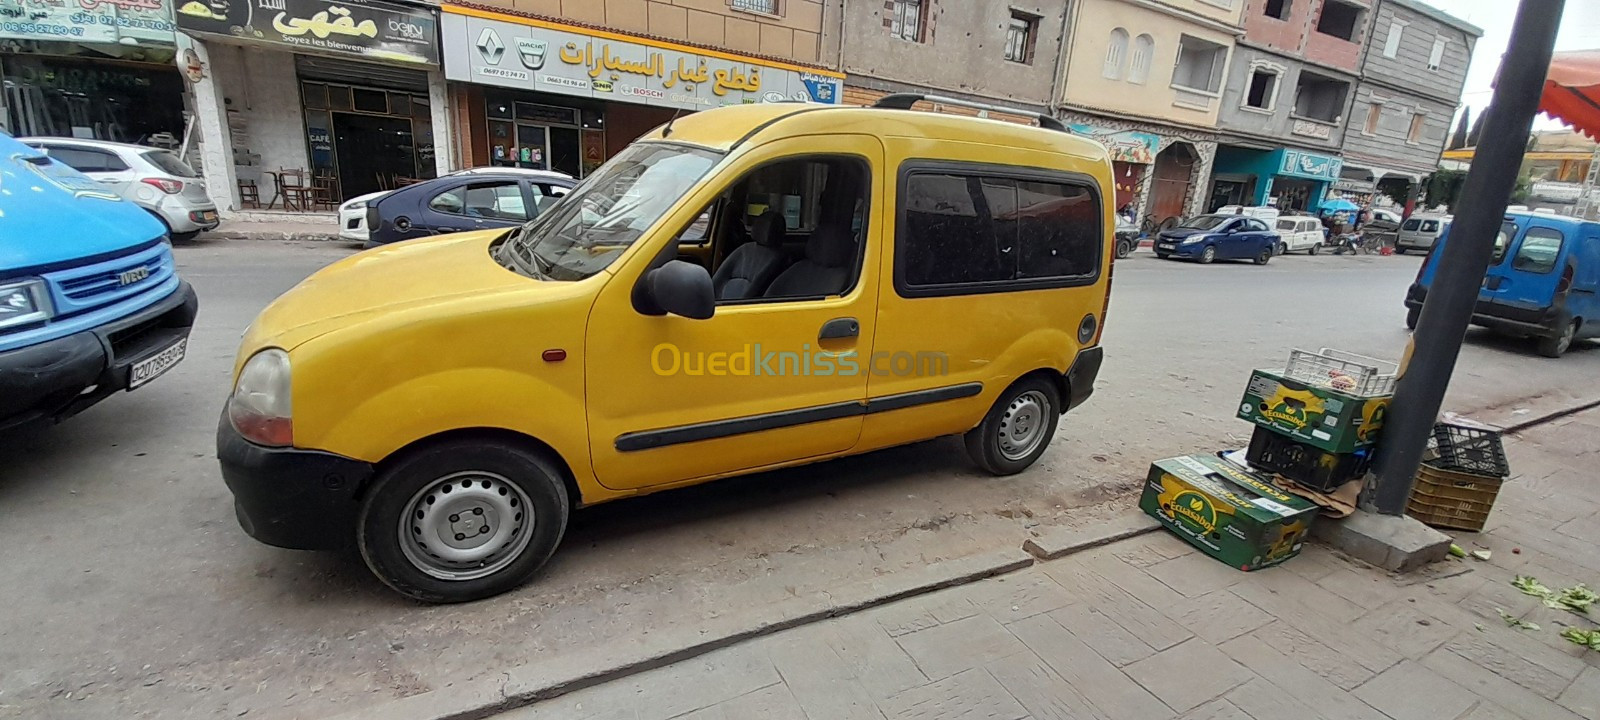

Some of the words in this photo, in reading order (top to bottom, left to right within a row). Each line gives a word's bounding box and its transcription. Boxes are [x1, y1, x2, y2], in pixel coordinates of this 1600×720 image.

[4, 22, 18, 31] 06
[37, 25, 51, 34] 27
[53, 26, 69, 35] 90
[70, 28, 85, 36] 47
[272, 5, 379, 39] مقهى
[282, 34, 310, 44] Soyez
[312, 39, 326, 47] les
[519, 41, 544, 49] DACIA
[560, 42, 664, 81] السيارات
[662, 56, 711, 92] غيار
[713, 66, 760, 96] قطع
[633, 87, 664, 98] BOSCH
[119, 266, 149, 286] IVECO
[1267, 409, 1307, 428] Ecuasabor
[1169, 500, 1216, 532] Ecuasabor
